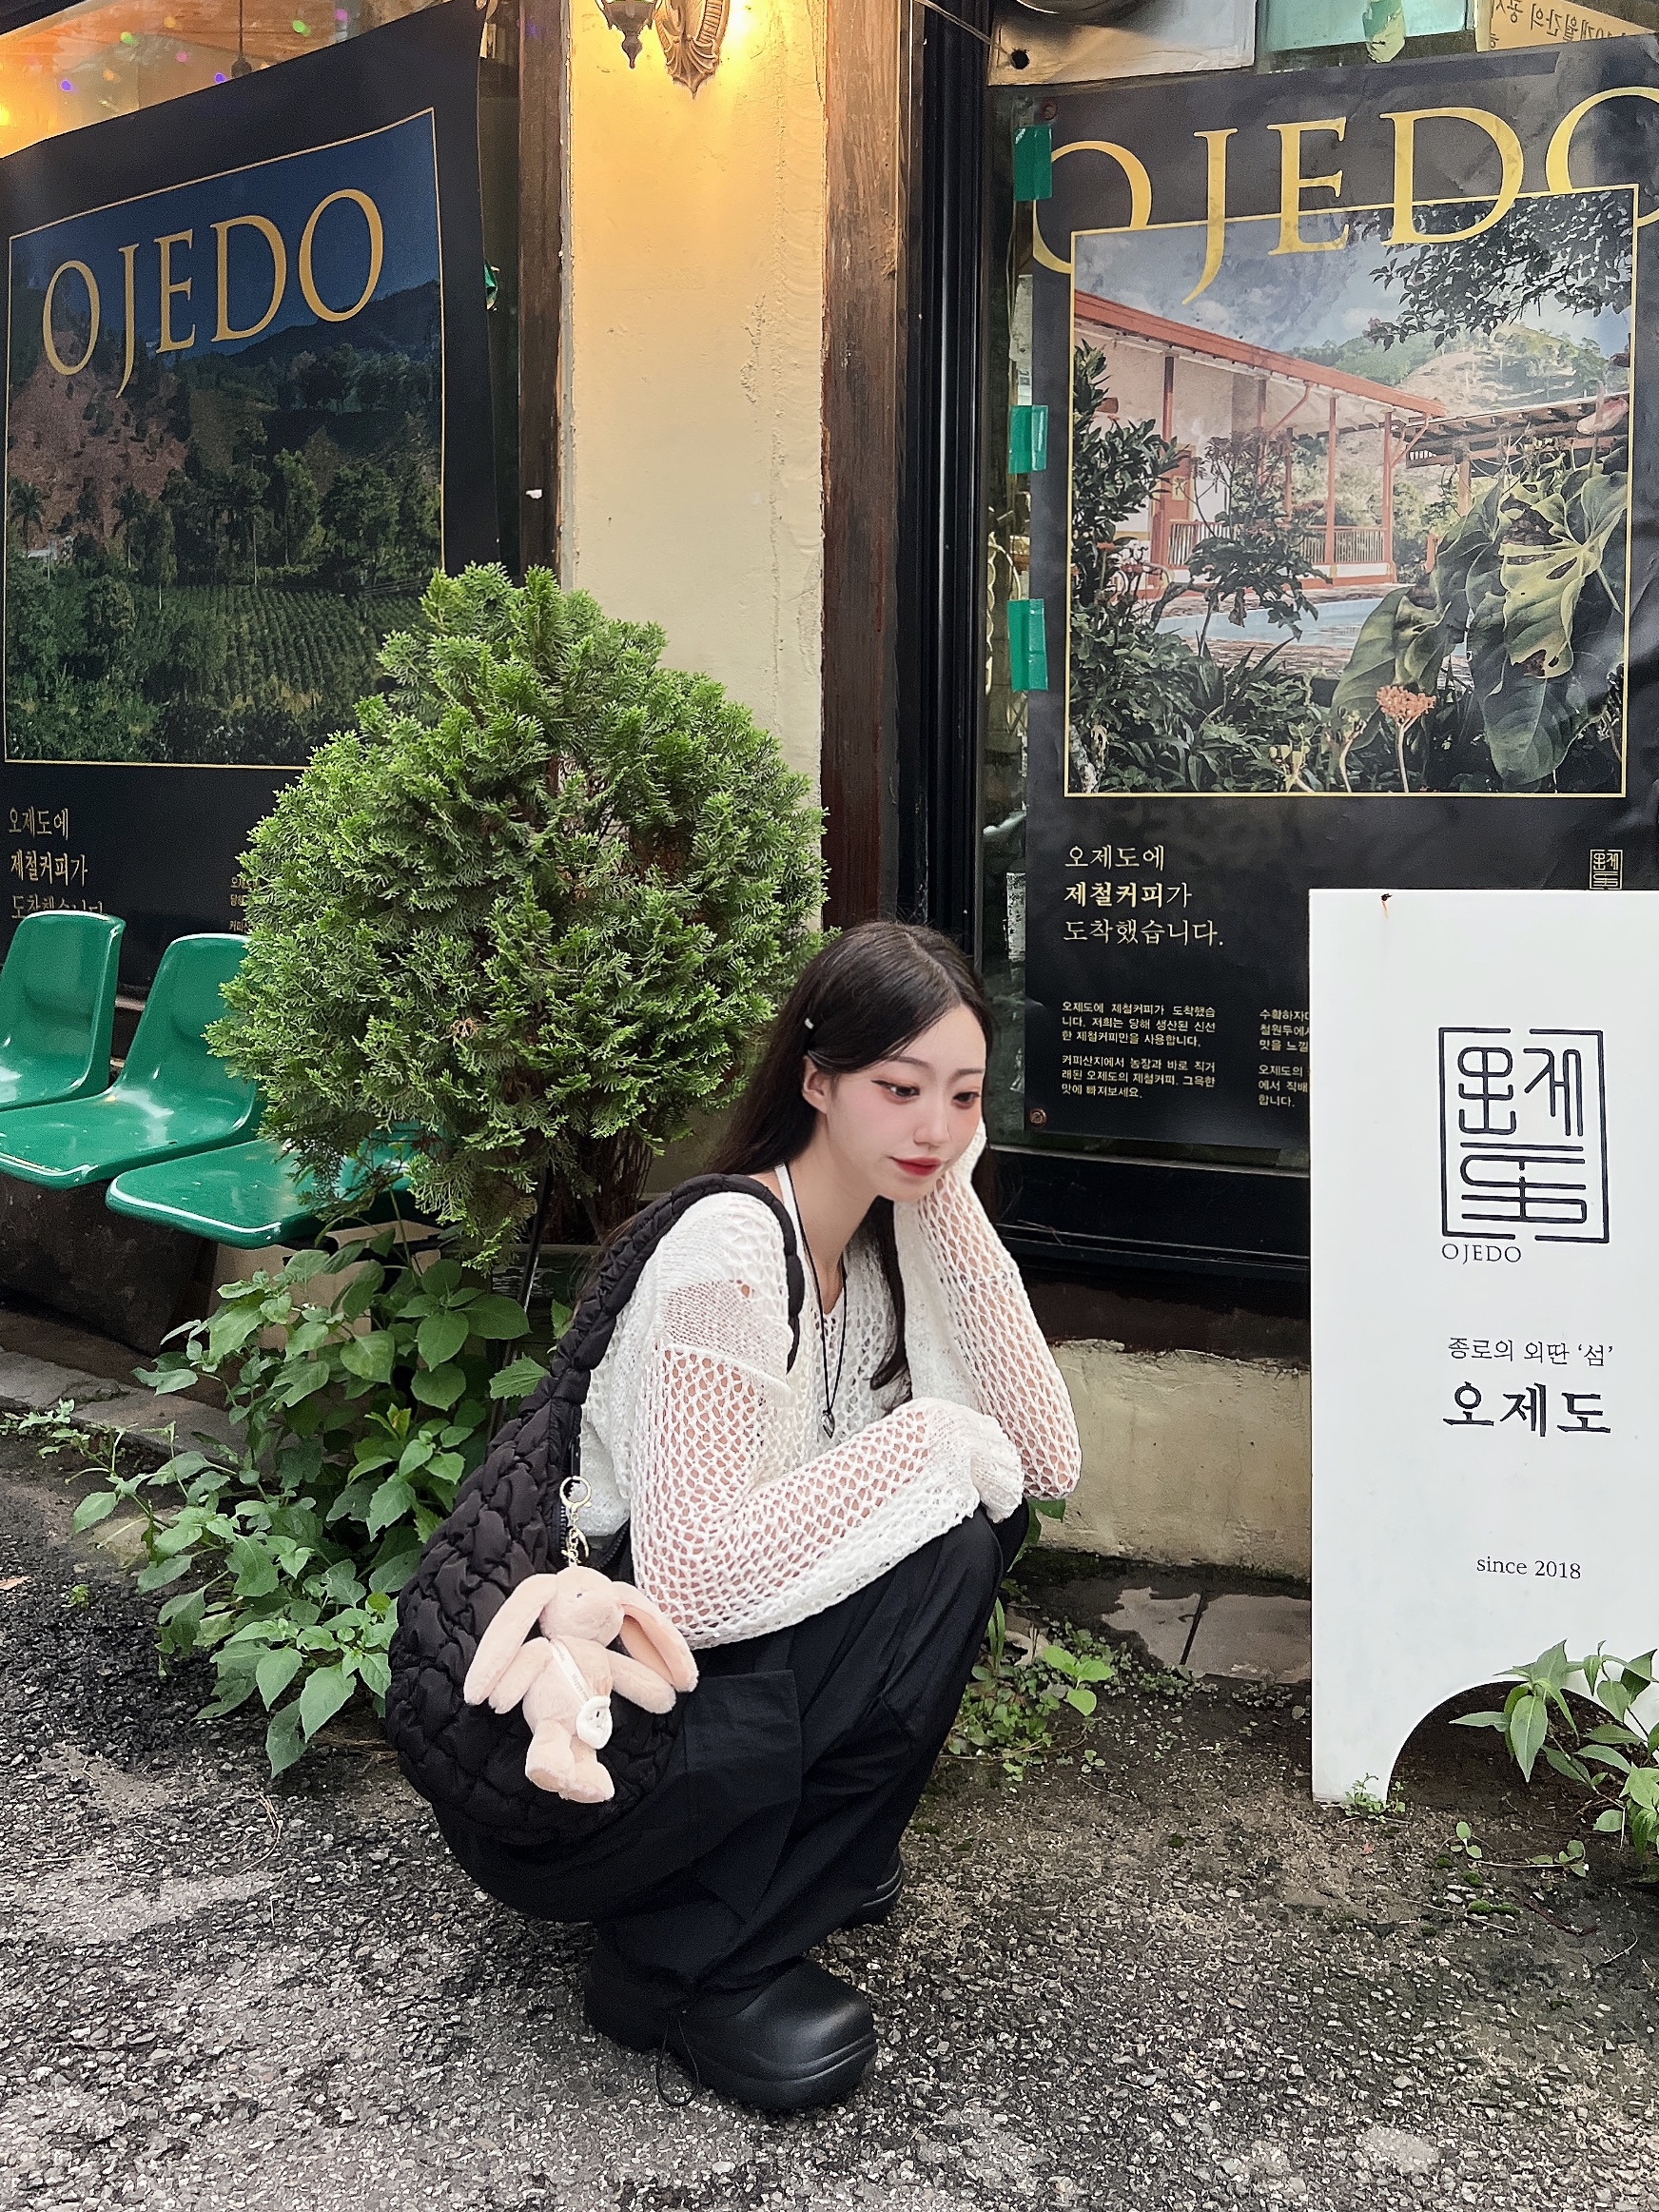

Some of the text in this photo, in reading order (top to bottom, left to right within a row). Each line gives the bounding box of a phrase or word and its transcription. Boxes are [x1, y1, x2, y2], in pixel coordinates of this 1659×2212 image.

[1032, 86, 1659, 305] OJEDO
[42, 188, 384, 398] OJEDO
[9, 807, 68, 840] 오제도에
[10, 849, 88, 886] 제철커피가
[1064, 844, 1165, 871] 오제도에
[1064, 881, 1192, 909] 제철커피가
[1063, 919, 1224, 947] 도착했습니다.
[1062, 1001, 1216, 1018] 오제도에 제철커피가 도착했습
[1062, 1016, 1216, 1033] 니다. 저희는 당해 생산된 신선
[1062, 1029, 1200, 1047] 한 제철커피만을 사용합니다.
[1259, 1039, 1281, 1051] 맛을
[1062, 1054, 1216, 1073] 커피산지에서 농장과 바로 직거
[1259, 1065, 1303, 1077] 오제도의
[1062, 1069, 1082, 1081] 래된
[1086, 1070, 1128, 1083] 오제도의
[1133, 1072, 1179, 1086] 제철커피.
[1259, 1080, 1280, 1091] 에서
[1062, 1084, 1083, 1095] 맛에
[1259, 1094, 1295, 1107] 합니다.
[1441, 1243, 1522, 1264] OJEDO
[1448, 1337, 1513, 1361] 종로의
[1523, 1341, 1570, 1364] 외딴
[1442, 1380, 1611, 1438] 오제도
[1476, 1556, 1582, 1579] since 2018
